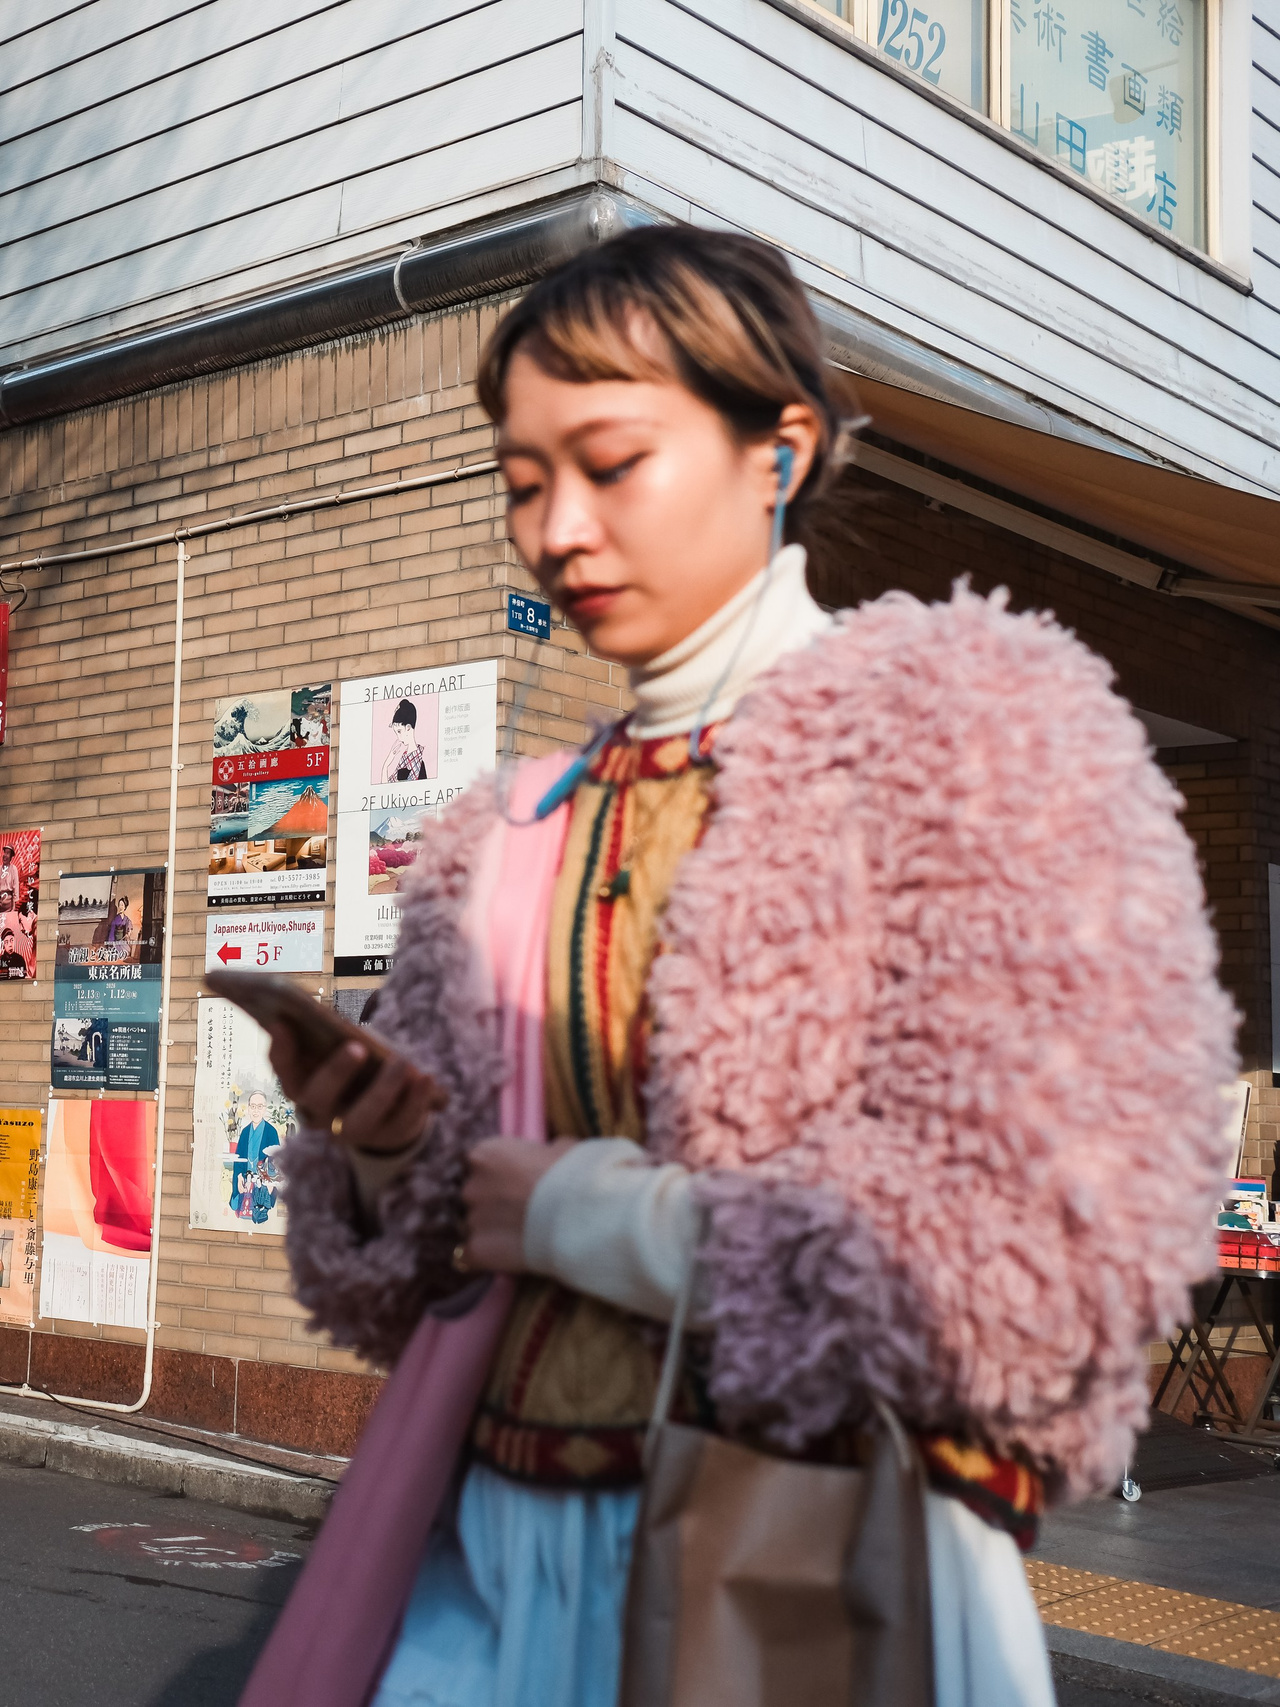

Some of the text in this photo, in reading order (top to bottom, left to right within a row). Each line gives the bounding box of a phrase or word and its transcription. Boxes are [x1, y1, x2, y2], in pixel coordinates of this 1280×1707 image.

[527, 607, 535, 623] 8
[364, 674, 466, 702] 3F Modern ART
[237, 757, 279, 771] 五拾画廊
[306, 752, 325, 767] 5F
[361, 796, 376, 811] 2F
[380, 790, 431, 811] Ukiyo-E
[278, 873, 321, 882] 03-5577-3985
[213, 923, 247, 936] Japanese
[88, 964, 142, 980] 東京名所展
